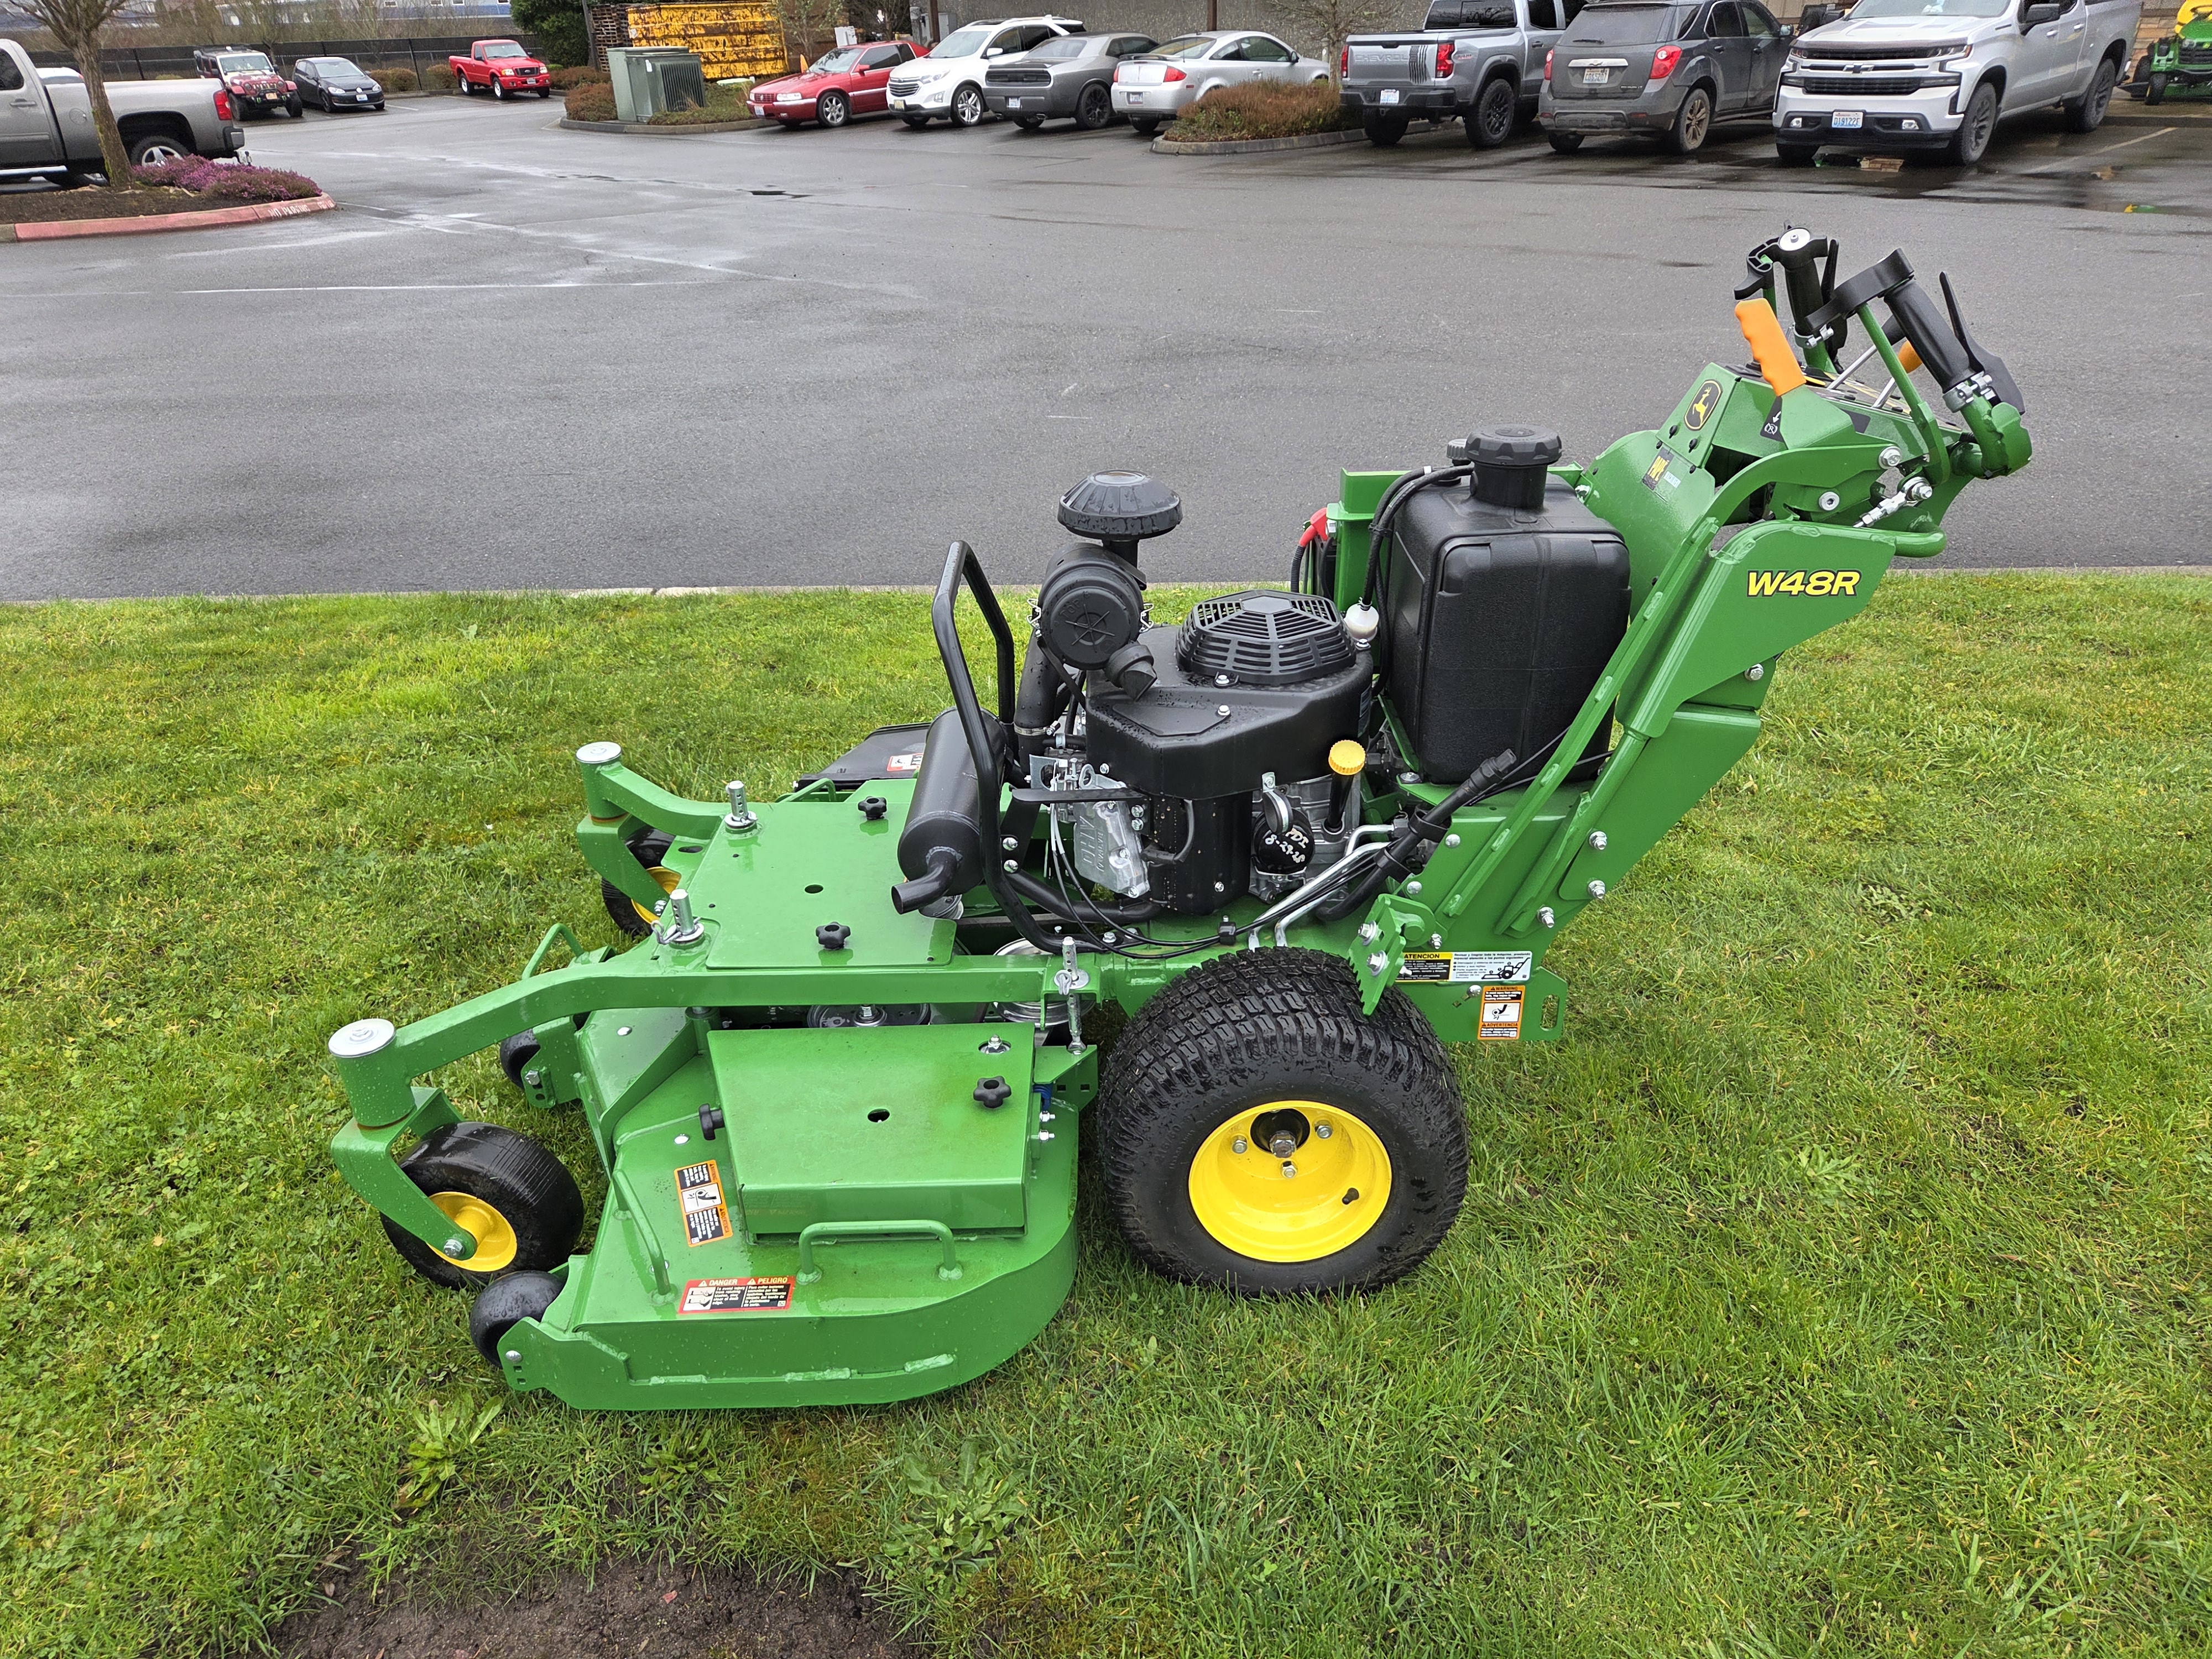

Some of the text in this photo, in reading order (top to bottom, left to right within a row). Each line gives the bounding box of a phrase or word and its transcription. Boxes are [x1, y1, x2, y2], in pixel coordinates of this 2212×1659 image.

[1355, 54, 1409, 62] CHEVROL
[268, 208, 282, 218] NO
[281, 205, 311, 216] PARKING
[1748, 570, 1861, 596] W48R
[1059, 598, 1081, 618] TOP
